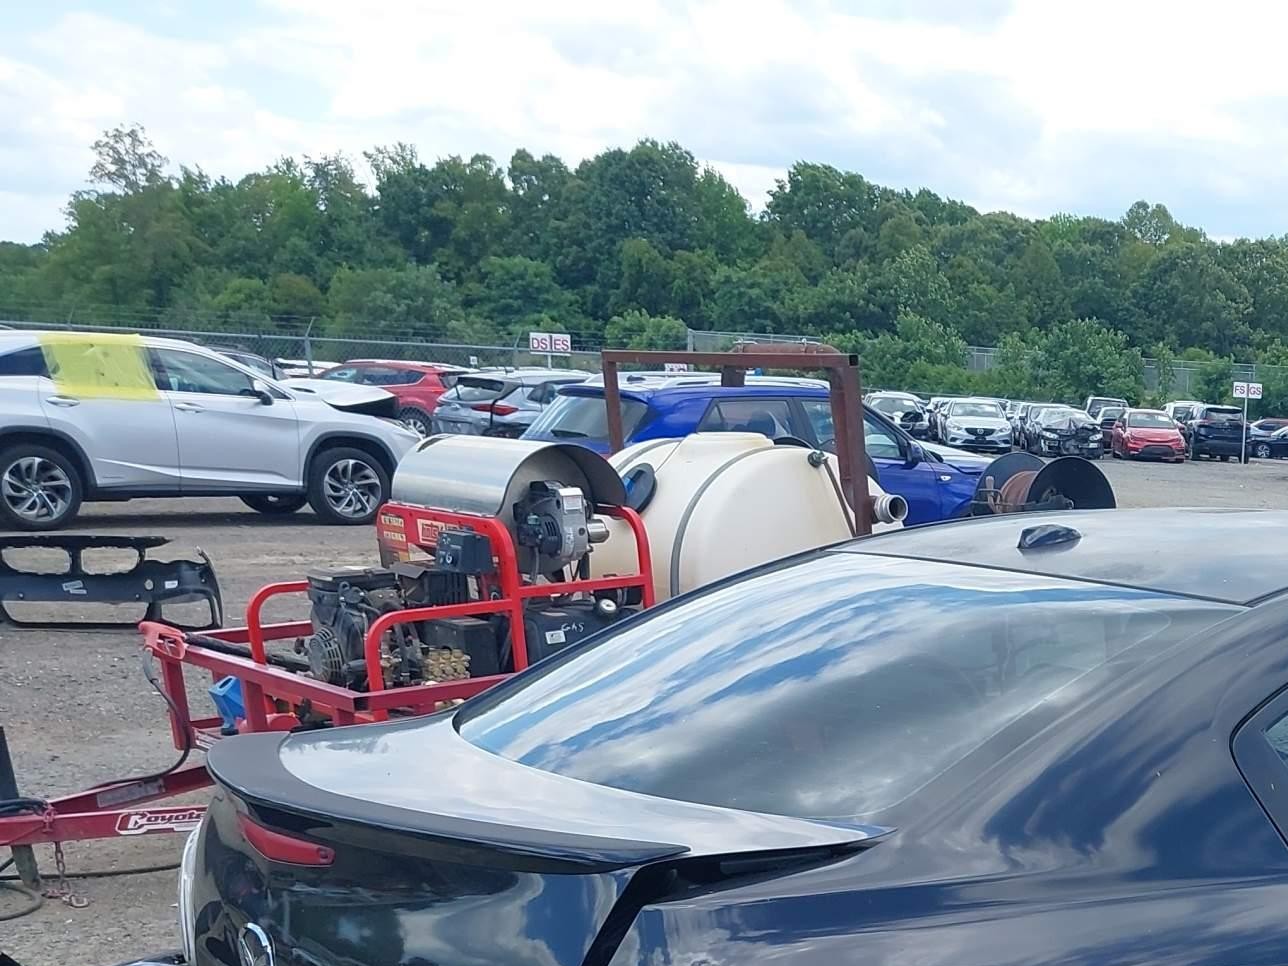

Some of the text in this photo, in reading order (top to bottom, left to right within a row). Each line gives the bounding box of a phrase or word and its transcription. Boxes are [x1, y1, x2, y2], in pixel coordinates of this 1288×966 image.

[531, 337, 570, 351] DS ES
[1234, 385, 1262, 396] FS GS
